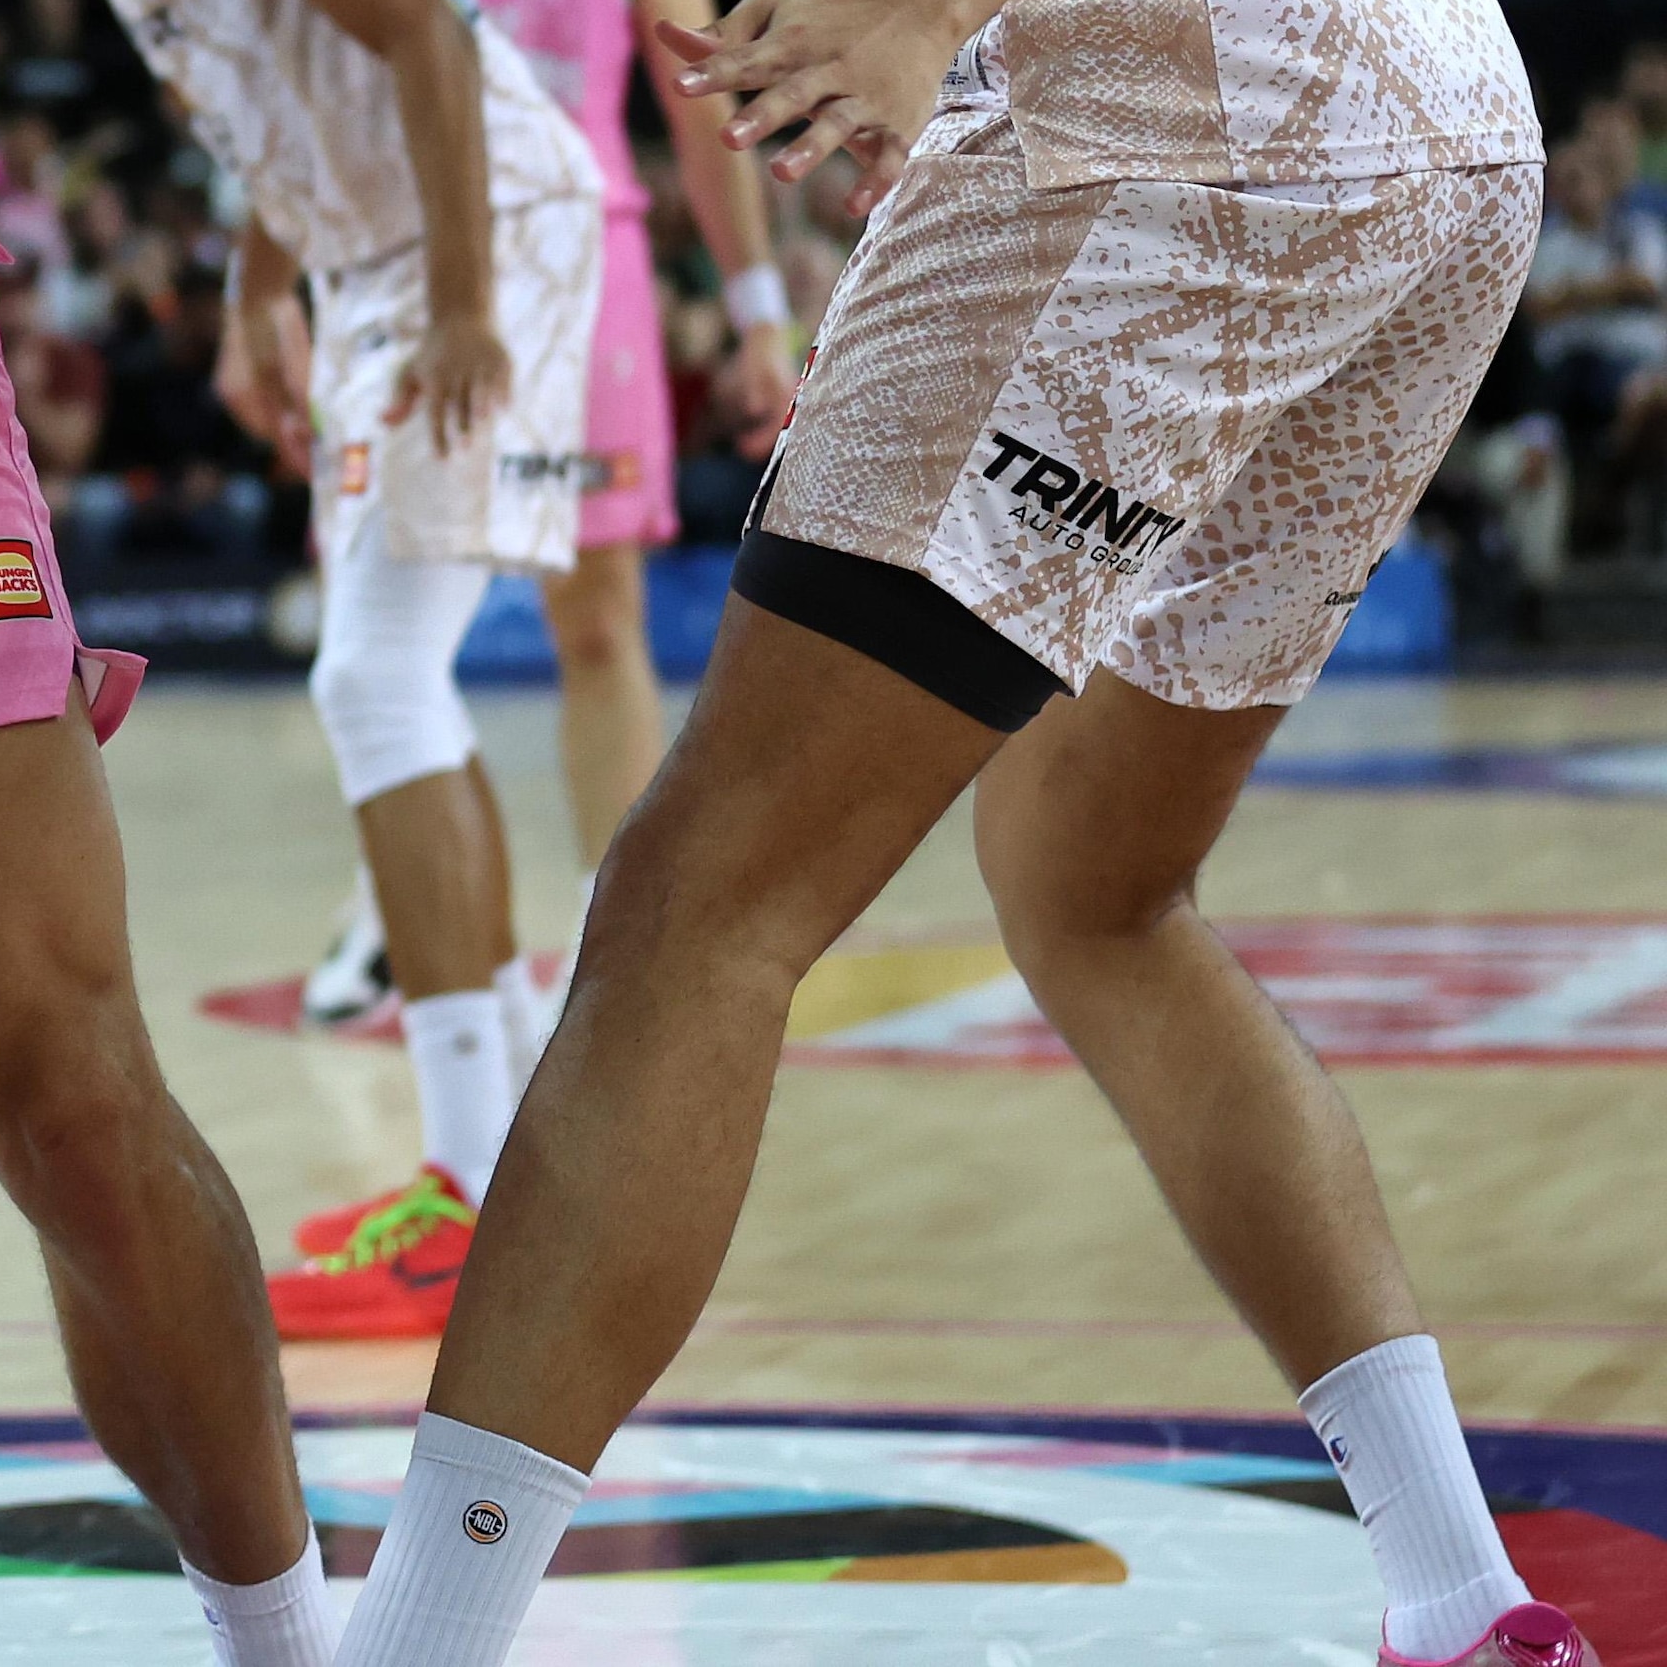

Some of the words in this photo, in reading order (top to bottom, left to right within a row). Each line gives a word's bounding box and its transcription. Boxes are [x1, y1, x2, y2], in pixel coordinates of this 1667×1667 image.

[983, 431, 1187, 558] TRINITY
[1008, 506, 1085, 550] AUTO
[473, 1510, 498, 1534] NBL
